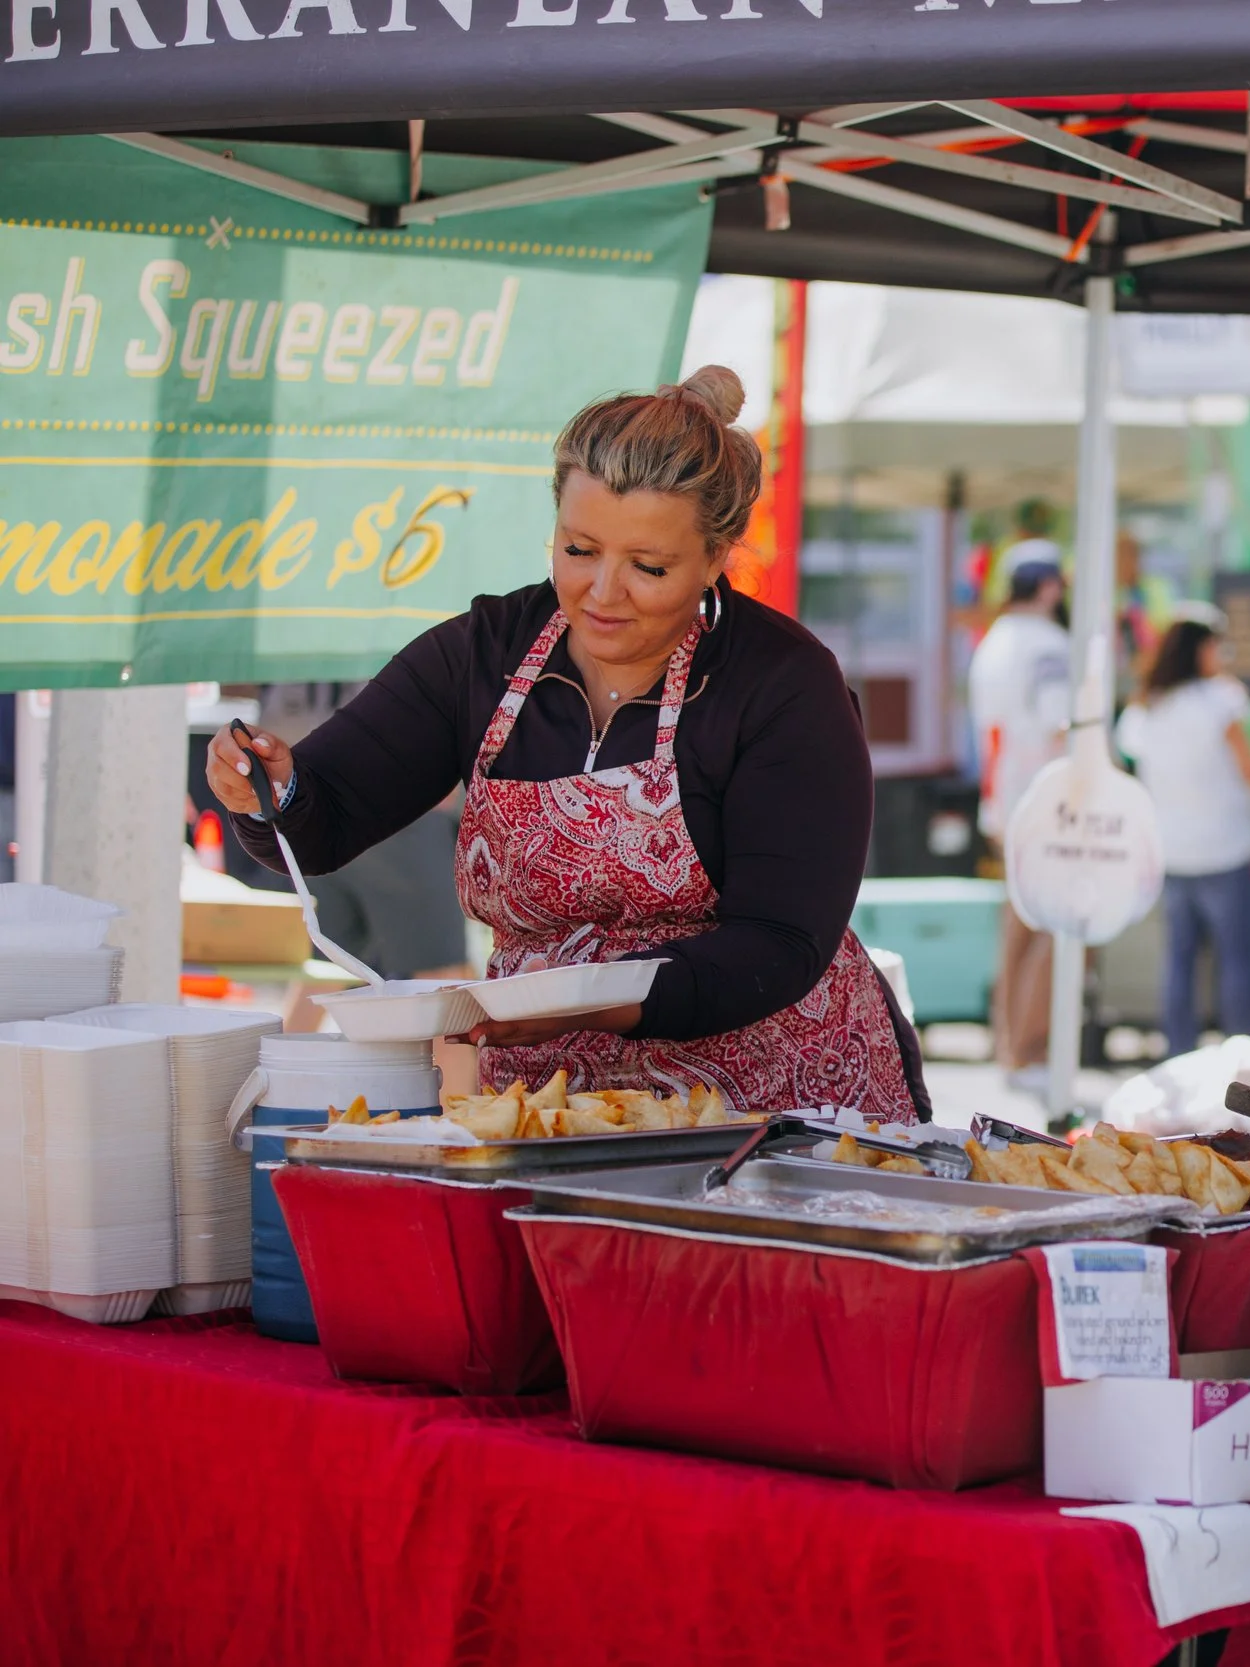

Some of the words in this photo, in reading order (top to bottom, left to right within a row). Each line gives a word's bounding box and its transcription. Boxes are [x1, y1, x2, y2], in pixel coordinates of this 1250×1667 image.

[0, 256, 101, 377] sh
[124, 259, 520, 402] Squeezed
[0, 486, 318, 596] monade
